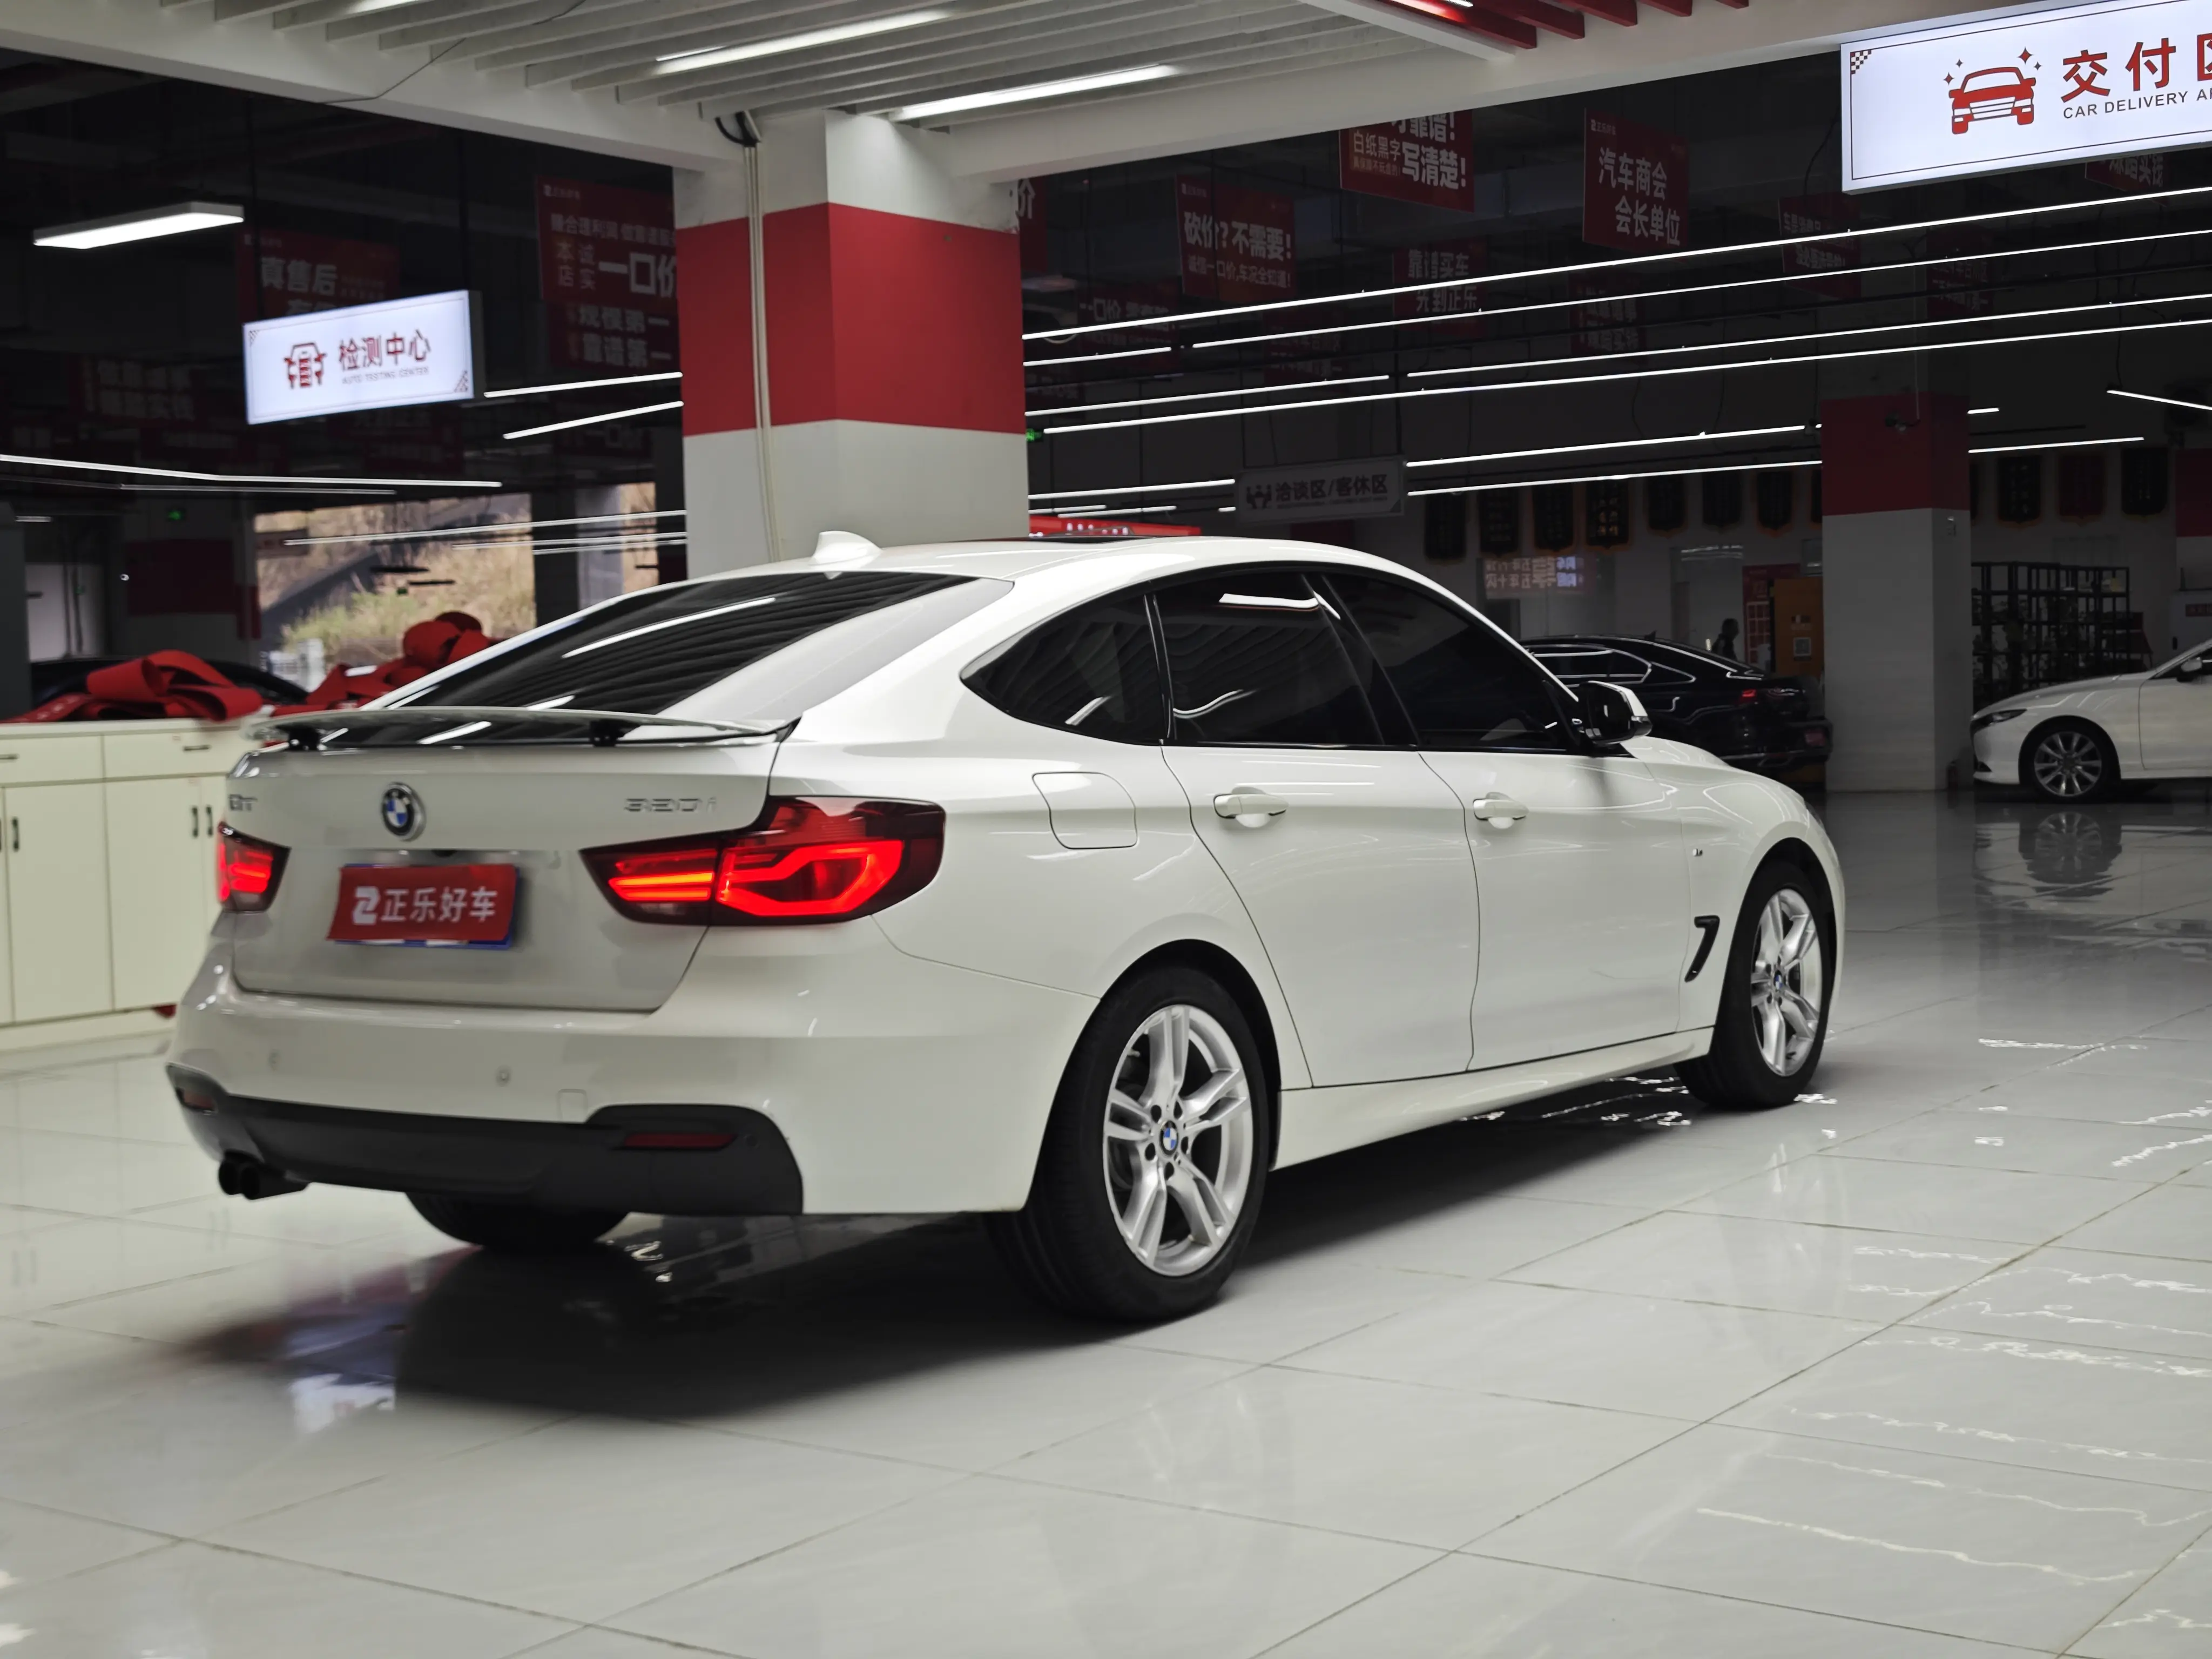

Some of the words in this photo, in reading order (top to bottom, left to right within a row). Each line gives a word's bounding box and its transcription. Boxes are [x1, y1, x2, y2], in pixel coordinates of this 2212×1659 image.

[2063, 104, 2097, 118] CAR
[2105, 91, 2188, 113] DELIVERY
[2196, 88, 2212, 100] A
[1353, 131, 1401, 162] 白纸黑字
[1402, 141, 1466, 190] 写清楚!
[1599, 147, 1667, 200] 汽车商会
[1615, 195, 1681, 246] 会长单位
[339, 329, 431, 372] 检测中心
[1276, 474, 1387, 502] 洽谈区/客休区
[381, 886, 498, 922] 正乐好车
